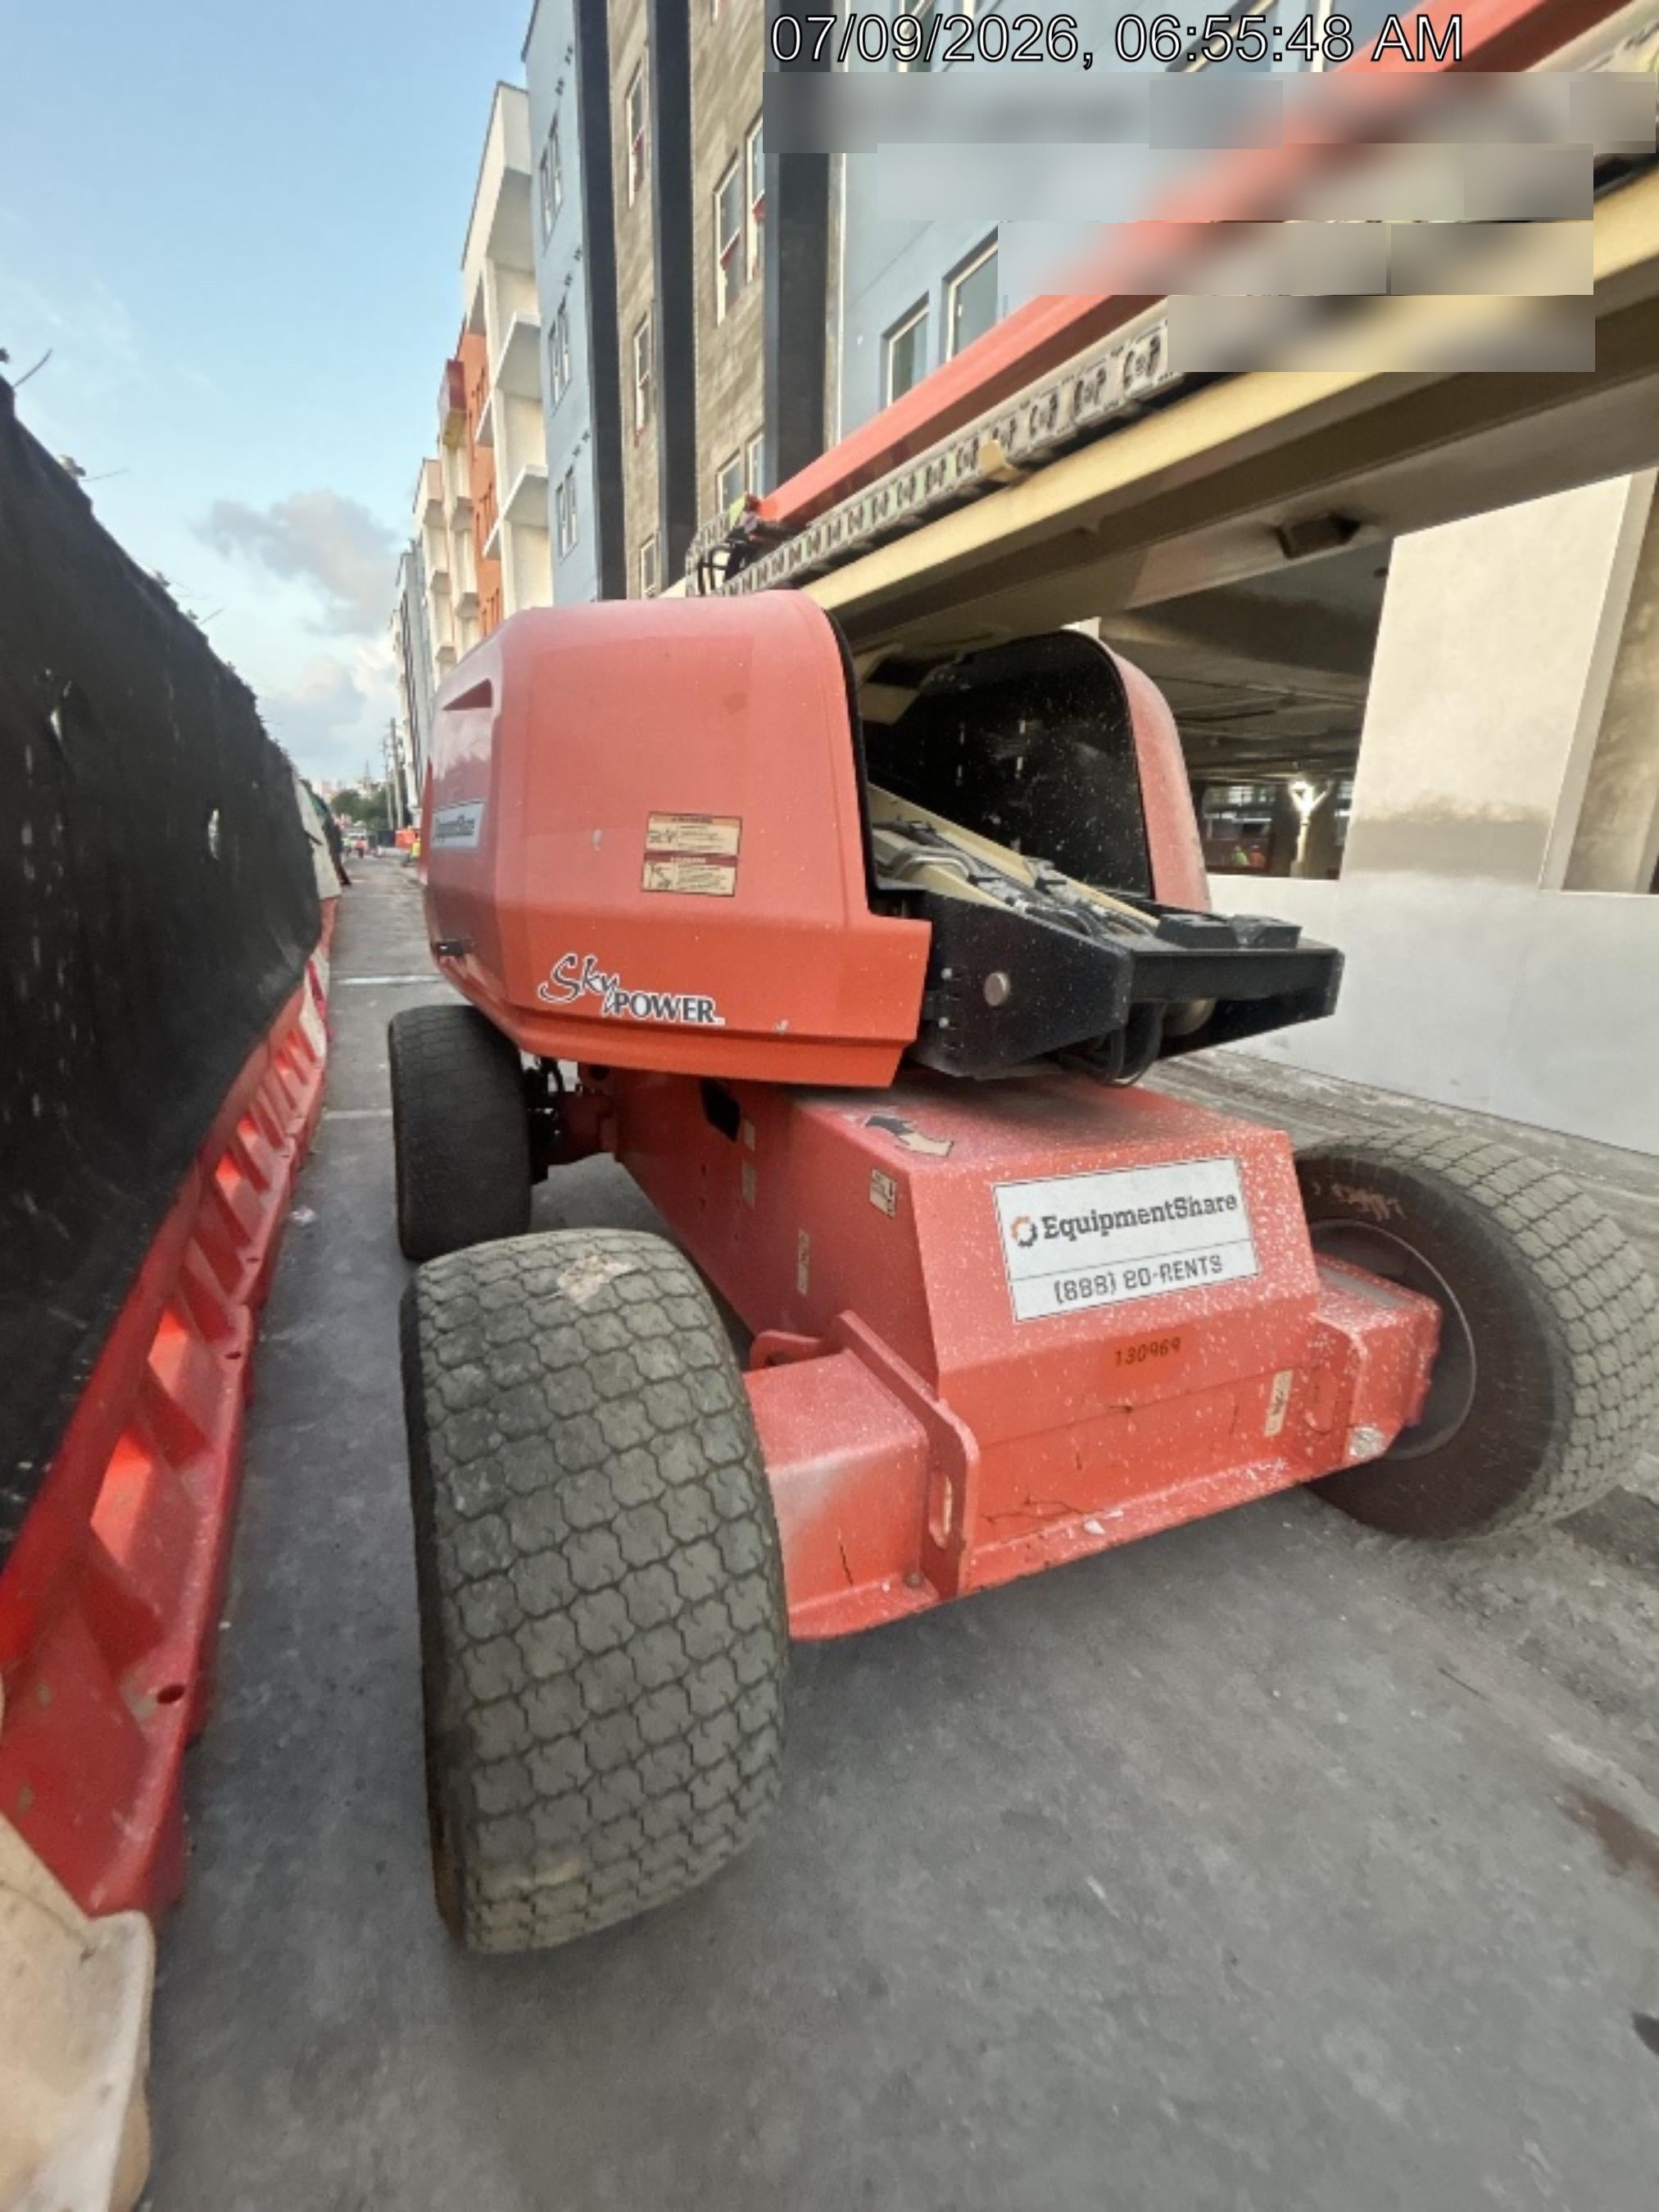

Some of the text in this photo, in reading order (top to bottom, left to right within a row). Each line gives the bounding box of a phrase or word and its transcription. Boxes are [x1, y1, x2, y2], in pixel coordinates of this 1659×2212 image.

[537, 954, 620, 1015] Sky
[613, 990, 717, 1023] POWER
[1042, 1194, 1238, 1241] EquipmentShare
[1054, 1272, 1117, 1304] (888)
